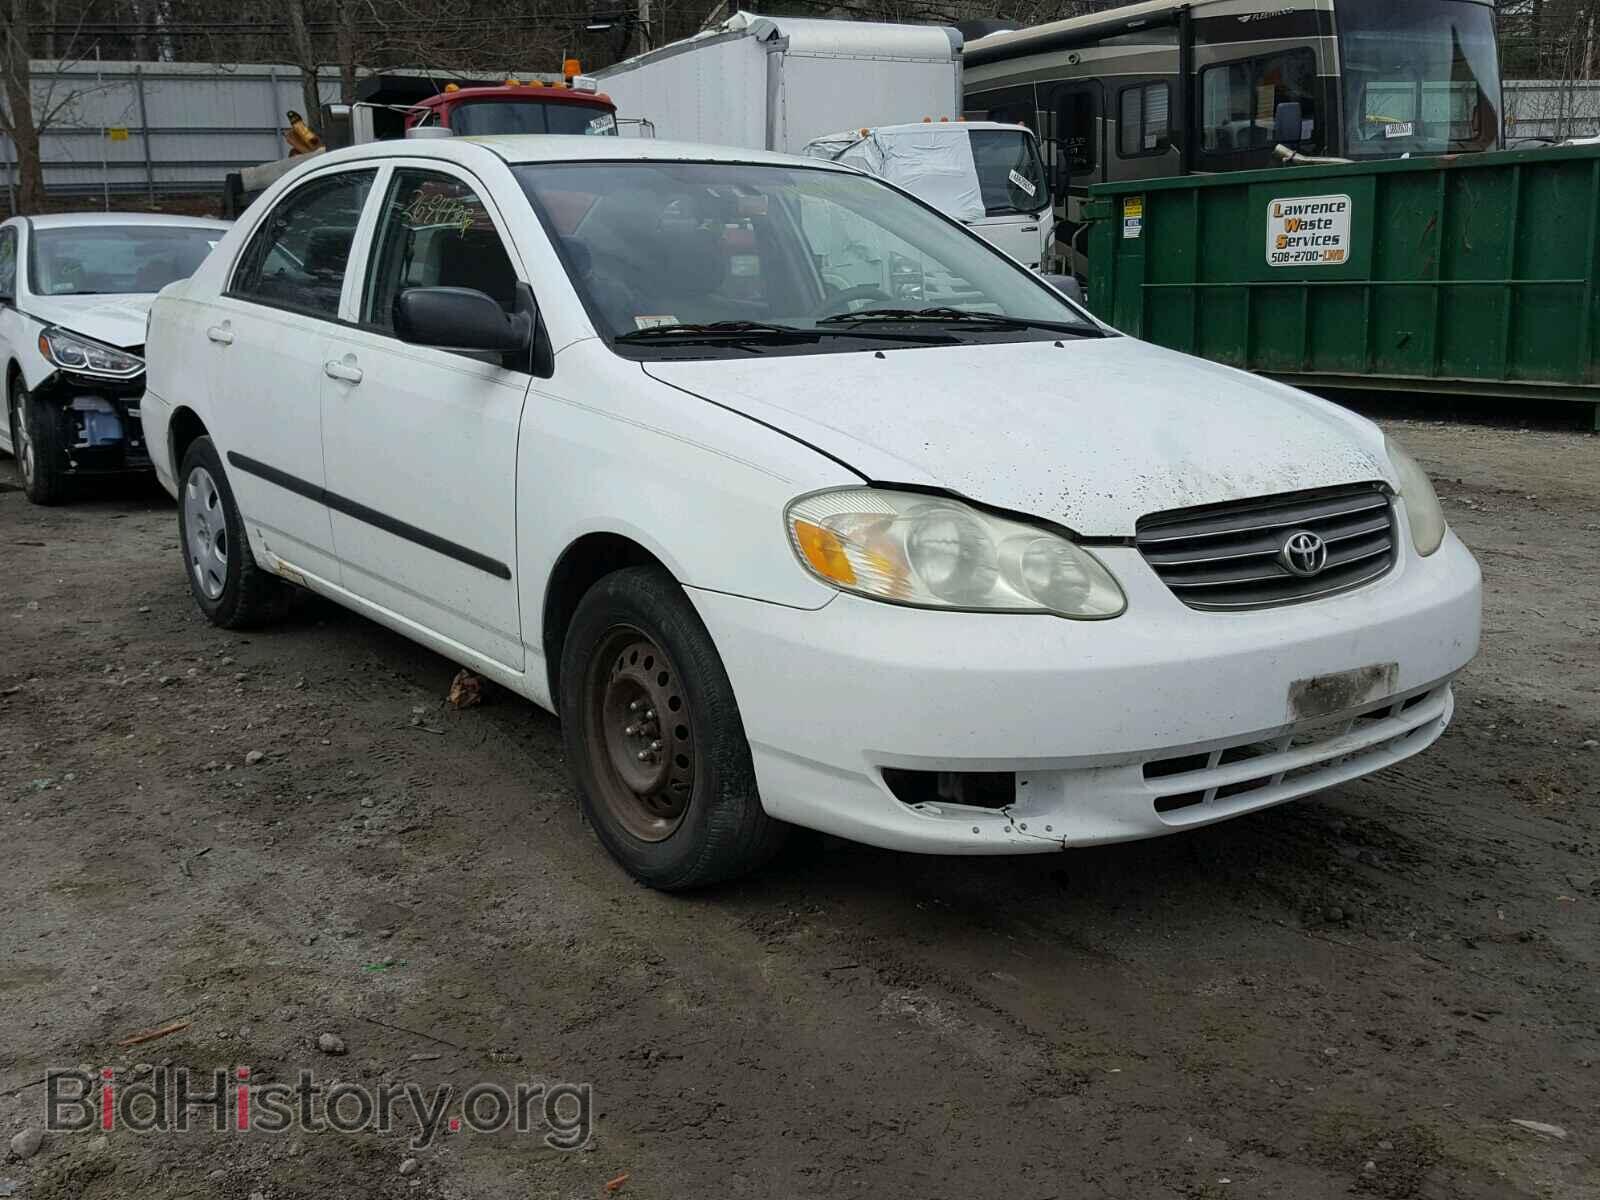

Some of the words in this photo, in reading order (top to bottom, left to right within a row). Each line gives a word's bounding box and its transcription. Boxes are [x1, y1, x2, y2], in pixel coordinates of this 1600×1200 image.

[1273, 202, 1346, 218] Lawrence
[1284, 217, 1333, 233] Waste
[1275, 233, 1340, 249] Services
